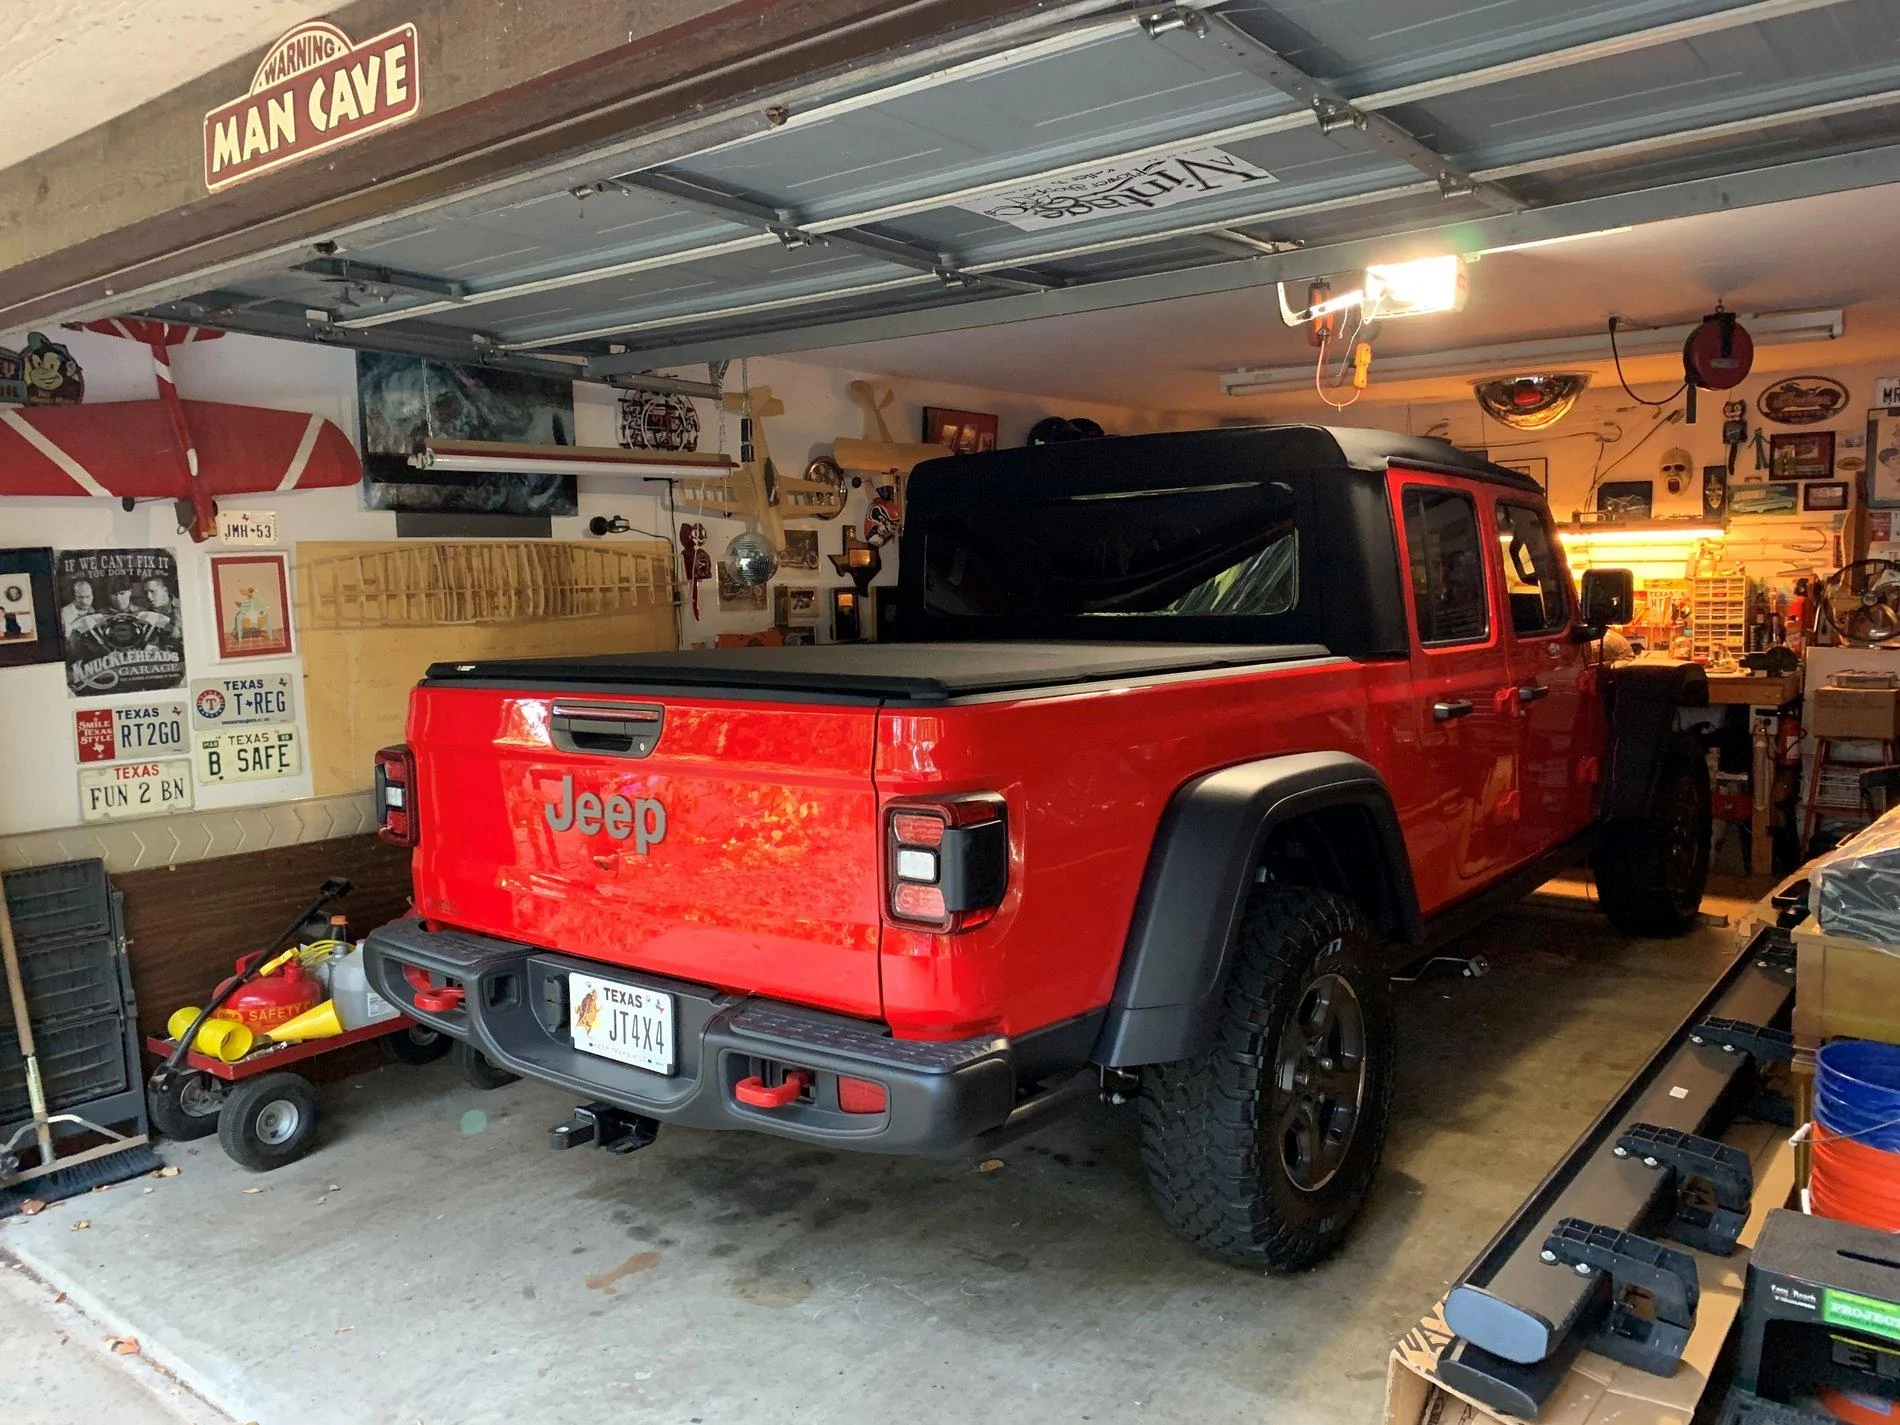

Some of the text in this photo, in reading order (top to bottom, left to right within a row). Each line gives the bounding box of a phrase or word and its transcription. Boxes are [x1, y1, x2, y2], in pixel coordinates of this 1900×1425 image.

[264, 34, 335, 85] WARNING
[212, 43, 408, 174] MAN CAVE
[1034, 158, 1269, 219] Vintage
[224, 524, 271, 539] JMH 53
[65, 555, 169, 573] IF WE CAN'T FIX IT
[88, 568, 152, 579] YOU DON'T PAY
[71, 648, 180, 684] KNUCKLEHEADS
[118, 664, 180, 675] GARAGE
[224, 679, 264, 691] TEXAS
[233, 693, 243, 716] T
[254, 690, 286, 714] REG
[116, 708, 160, 720] TEXAS
[78, 720, 111, 730] SMILE
[84, 728, 113, 737] TEXAS
[80, 735, 113, 744] STYLE
[228, 733, 270, 746] TEXAS
[208, 744, 290, 776] B SAFE
[114, 764, 160, 780] TEXAS
[90, 778, 184, 810] FUN 2 BN
[545, 772, 668, 855] Jeep
[603, 987, 643, 1009] TEXAS
[249, 1003, 301, 1023] SAFETY
[609, 1009, 665, 1055] JT4X4
